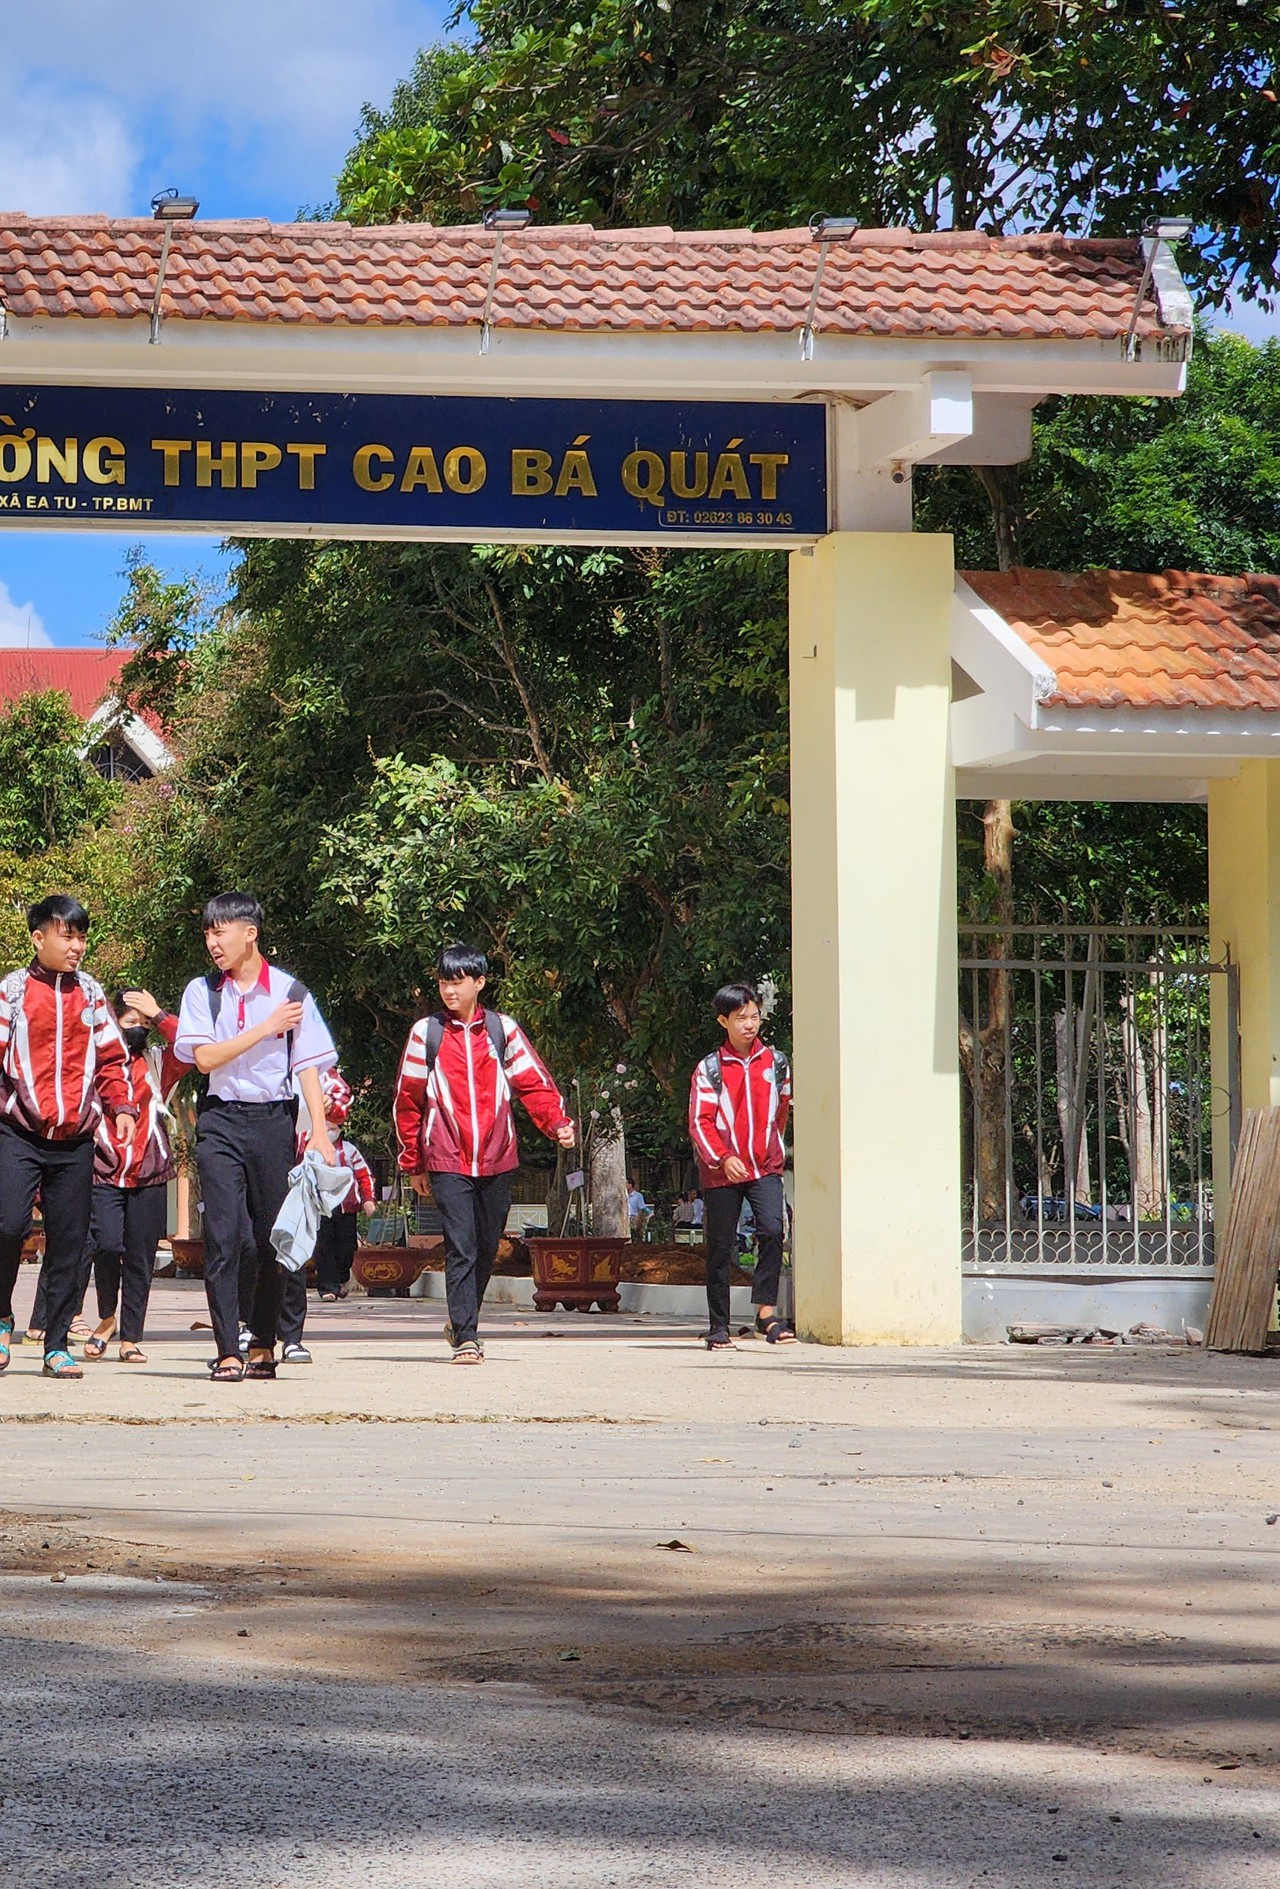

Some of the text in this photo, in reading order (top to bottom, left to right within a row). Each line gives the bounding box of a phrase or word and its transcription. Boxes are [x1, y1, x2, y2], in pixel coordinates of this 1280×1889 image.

[151, 439, 327, 490] THPT
[352, 443, 487, 494] CAO
[511, 435, 598, 497] BÁ
[621, 438, 790, 508] QUÁT
[26, 495, 49, 509] EA
[54, 496, 76, 510] TU
[92, 497, 154, 511] TP.BMT
[666, 510, 793, 525] ĐT: 02623 86 30 43
